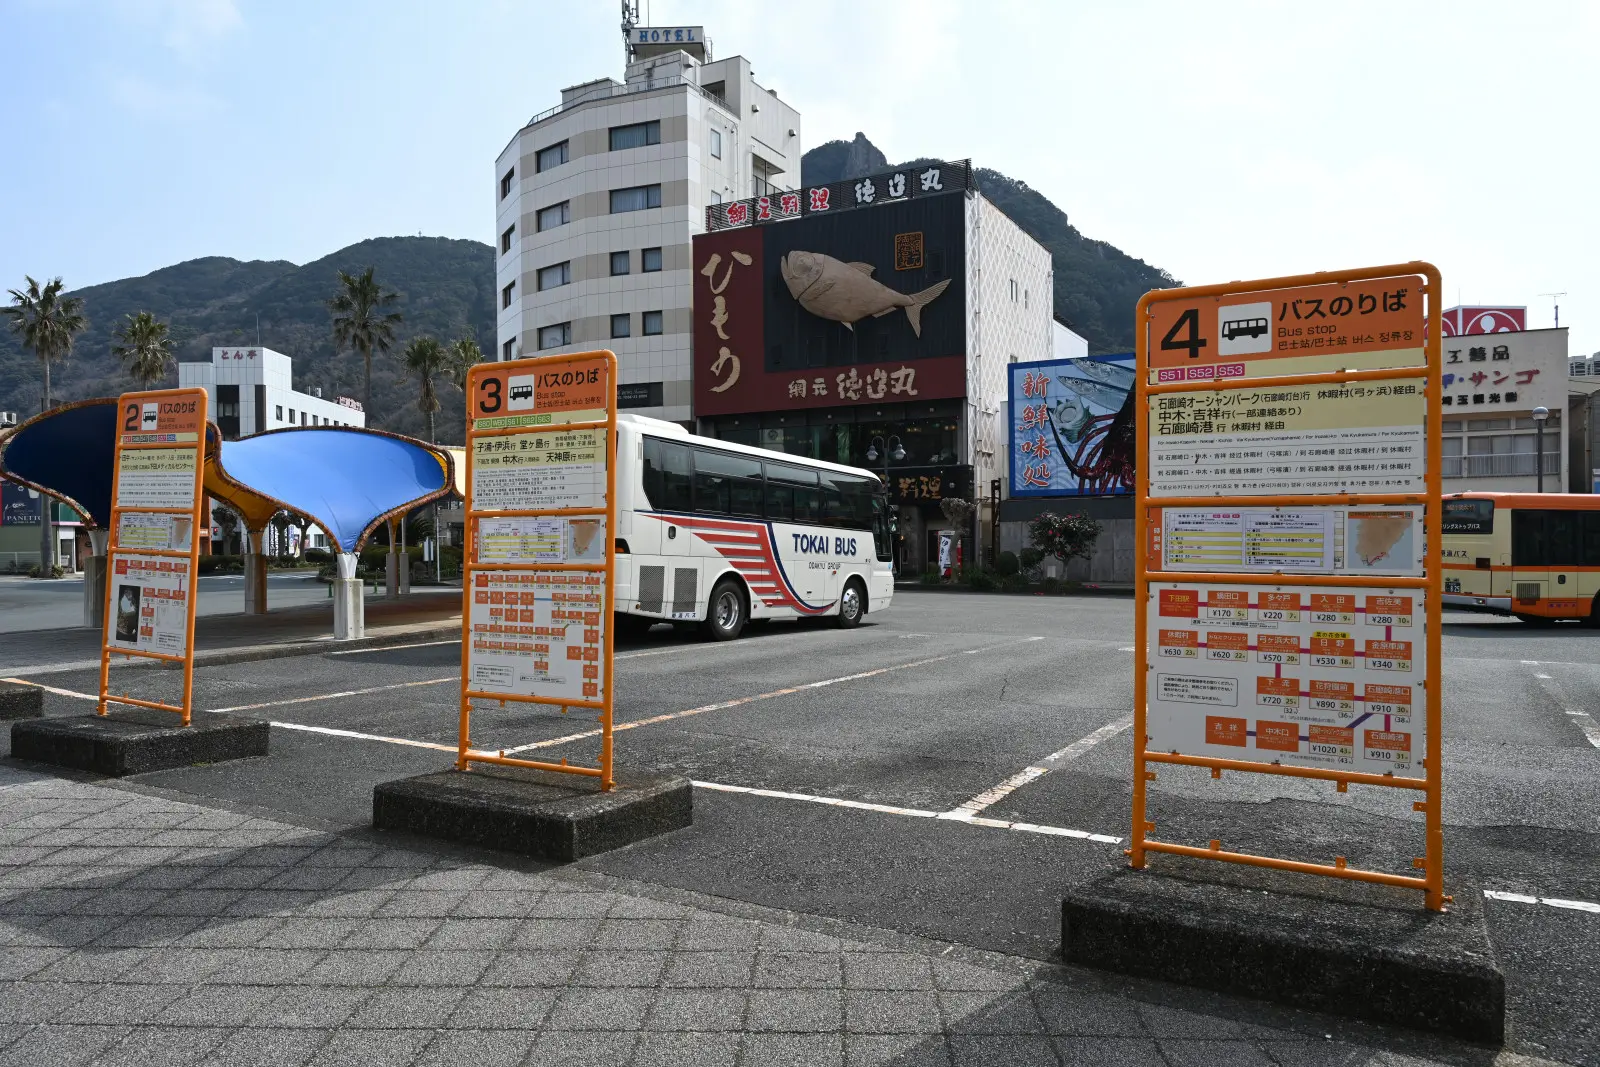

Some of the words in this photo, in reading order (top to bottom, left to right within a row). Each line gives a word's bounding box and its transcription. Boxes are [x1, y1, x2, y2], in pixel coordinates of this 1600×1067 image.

[639, 29, 695, 43] HOTEL
[727, 187, 830, 225] 網元料理
[1278, 288, 1408, 322] バスのりば
[701, 250, 753, 393] ひもの
[1161, 308, 1206, 359] 4
[1278, 327, 1303, 338] Bus
[1307, 324, 1337, 335] stop
[1352, 333, 1374, 345] 버스
[1379, 330, 1413, 343] 정류장
[221, 350, 257, 360] とん亭
[537, 367, 599, 389] バスのりば
[1160, 370, 1183, 381] S51
[1189, 368, 1213, 379] S52
[1219, 365, 1243, 377] S53
[788, 377, 828, 398] 網元
[479, 377, 502, 414] 3
[536, 391, 549, 400] Bus
[550, 391, 566, 399] stop
[159, 400, 197, 415] バスのりば
[125, 403, 139, 432] 2
[1018, 371, 1051, 488] 新鮮味処
[1158, 421, 1213, 435] 石廊崎港
[1216, 423, 1226, 433] 行
[1231, 421, 1261, 432] 休暇村
[1264, 420, 1285, 431] 経由
[545, 451, 577, 463] 天神原行
[792, 533, 829, 555] TOKAI
[835, 536, 857, 556] BUS
[1268, 594, 1291, 602] 多々戸
[1320, 595, 1345, 604] 入田
[1212, 609, 1231, 617] ¥170
[1317, 614, 1336, 622] ¥280
[1372, 616, 1392, 624] ¥280
[1212, 651, 1231, 659] ¥620
[1263, 654, 1282, 662] ¥570
[1316, 657, 1336, 665] ¥530
[1372, 660, 1392, 668] ¥340
[1262, 696, 1282, 704] ¥720
[1316, 700, 1336, 709] ¥890
[1371, 704, 1392, 713] ¥910
[1265, 727, 1289, 737] 中木口
[1312, 744, 1337, 754] ¥1020
[1370, 750, 1391, 759] ¥910
